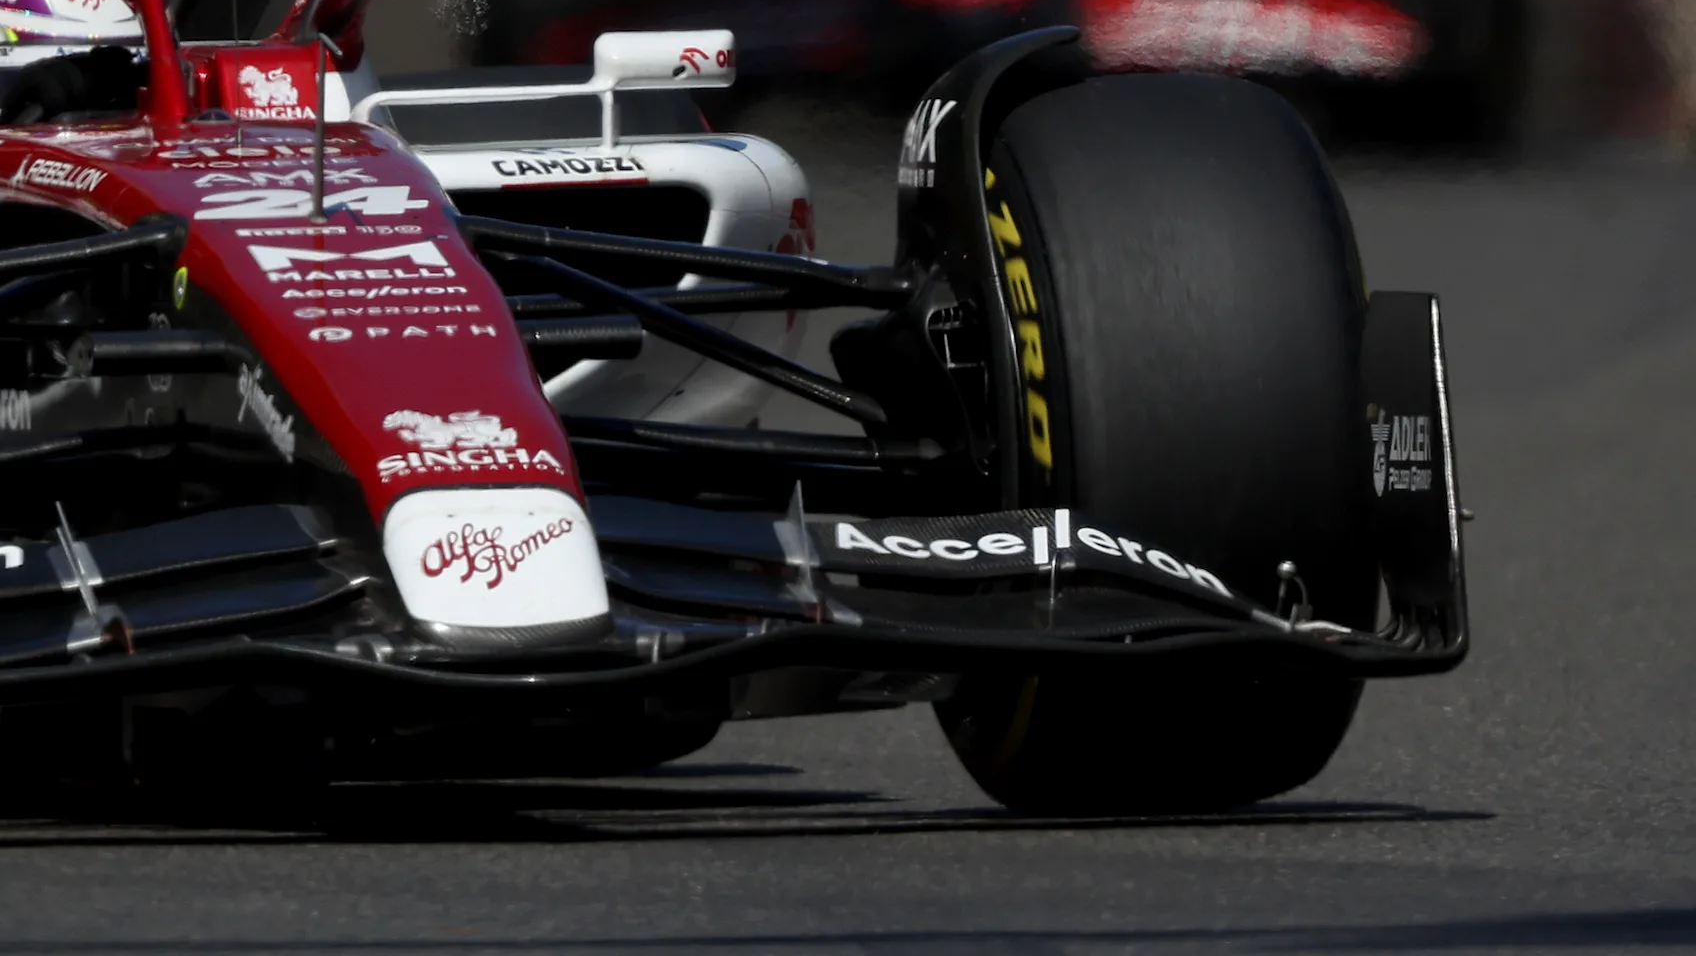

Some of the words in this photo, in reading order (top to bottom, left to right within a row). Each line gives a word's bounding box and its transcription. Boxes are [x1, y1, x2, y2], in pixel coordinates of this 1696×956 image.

[26, 158, 108, 192] REBELLION
[491, 156, 645, 177] CAMOZZI
[194, 185, 429, 220] 24
[266, 267, 457, 282] MARELLI
[365, 324, 497, 338] PATH
[988, 201, 1053, 470] ZERO
[376, 448, 562, 477] SINGHA
[421, 523, 494, 583] Alfa
[473, 518, 573, 590] Romeo
